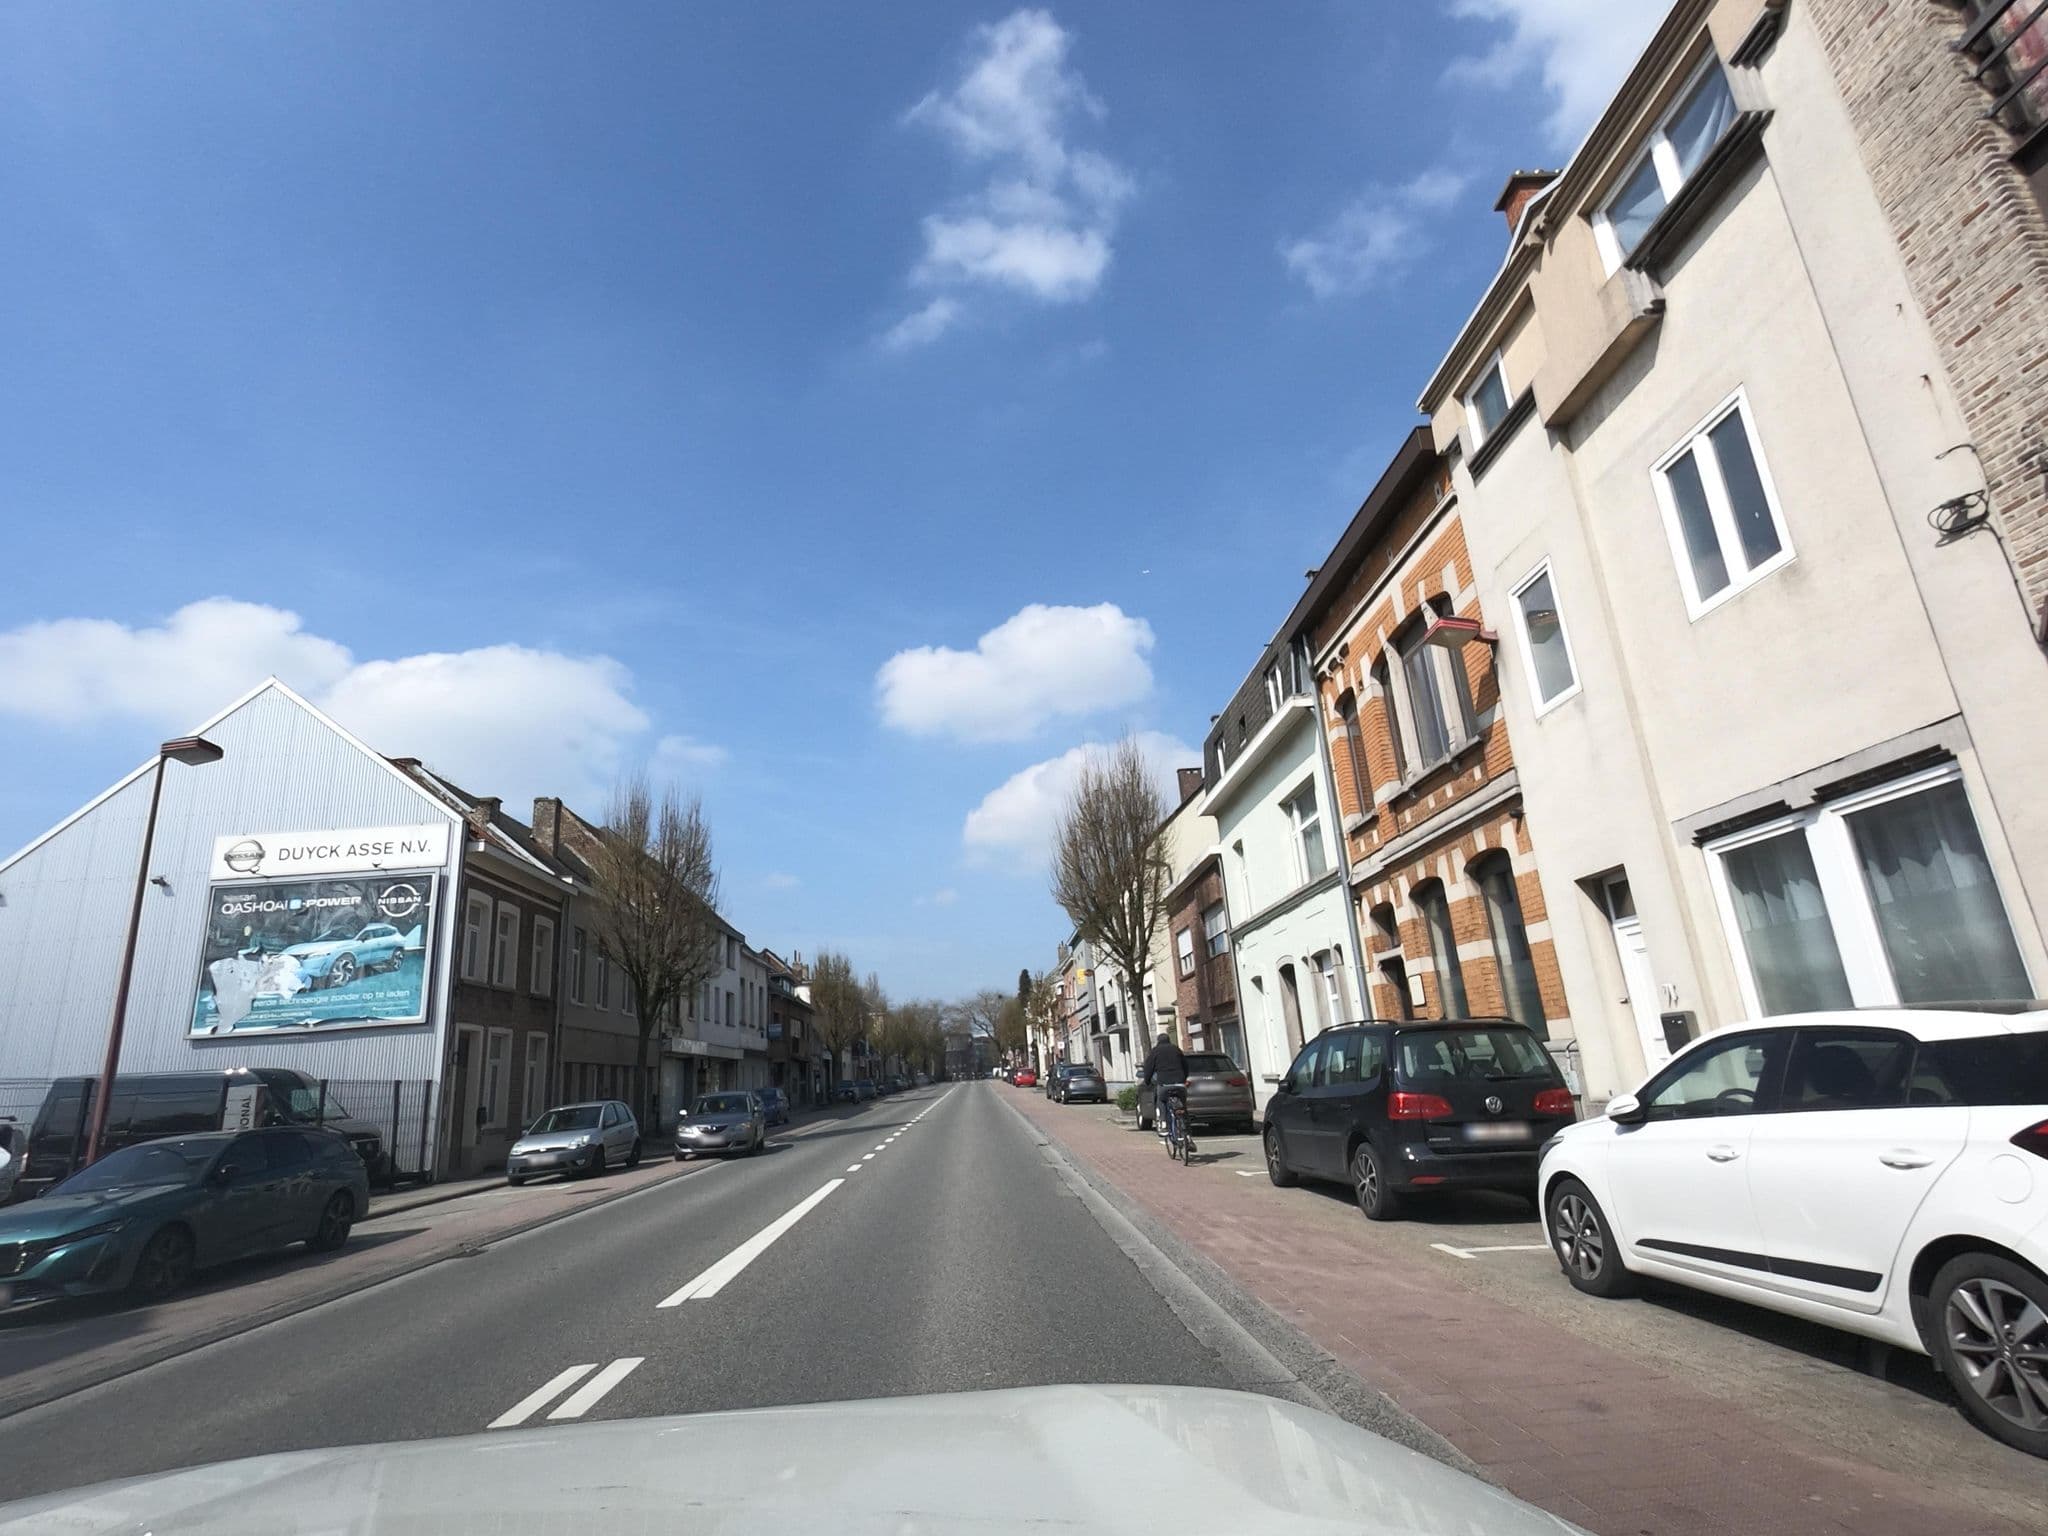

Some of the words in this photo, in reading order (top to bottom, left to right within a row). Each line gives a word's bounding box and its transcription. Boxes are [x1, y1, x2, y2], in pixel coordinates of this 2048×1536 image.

[278, 845, 340, 861] DUYCK
[346, 842, 394, 857] ASSE
[400, 839, 431, 854] N.V.
[377, 895, 422, 905] NISSAN
[221, 900, 288, 915] QASHQAI
[330, 993, 360, 1001] zonder
[362, 992, 374, 1002] op
[376, 990, 385, 998] te
[386, 989, 410, 997] laden
